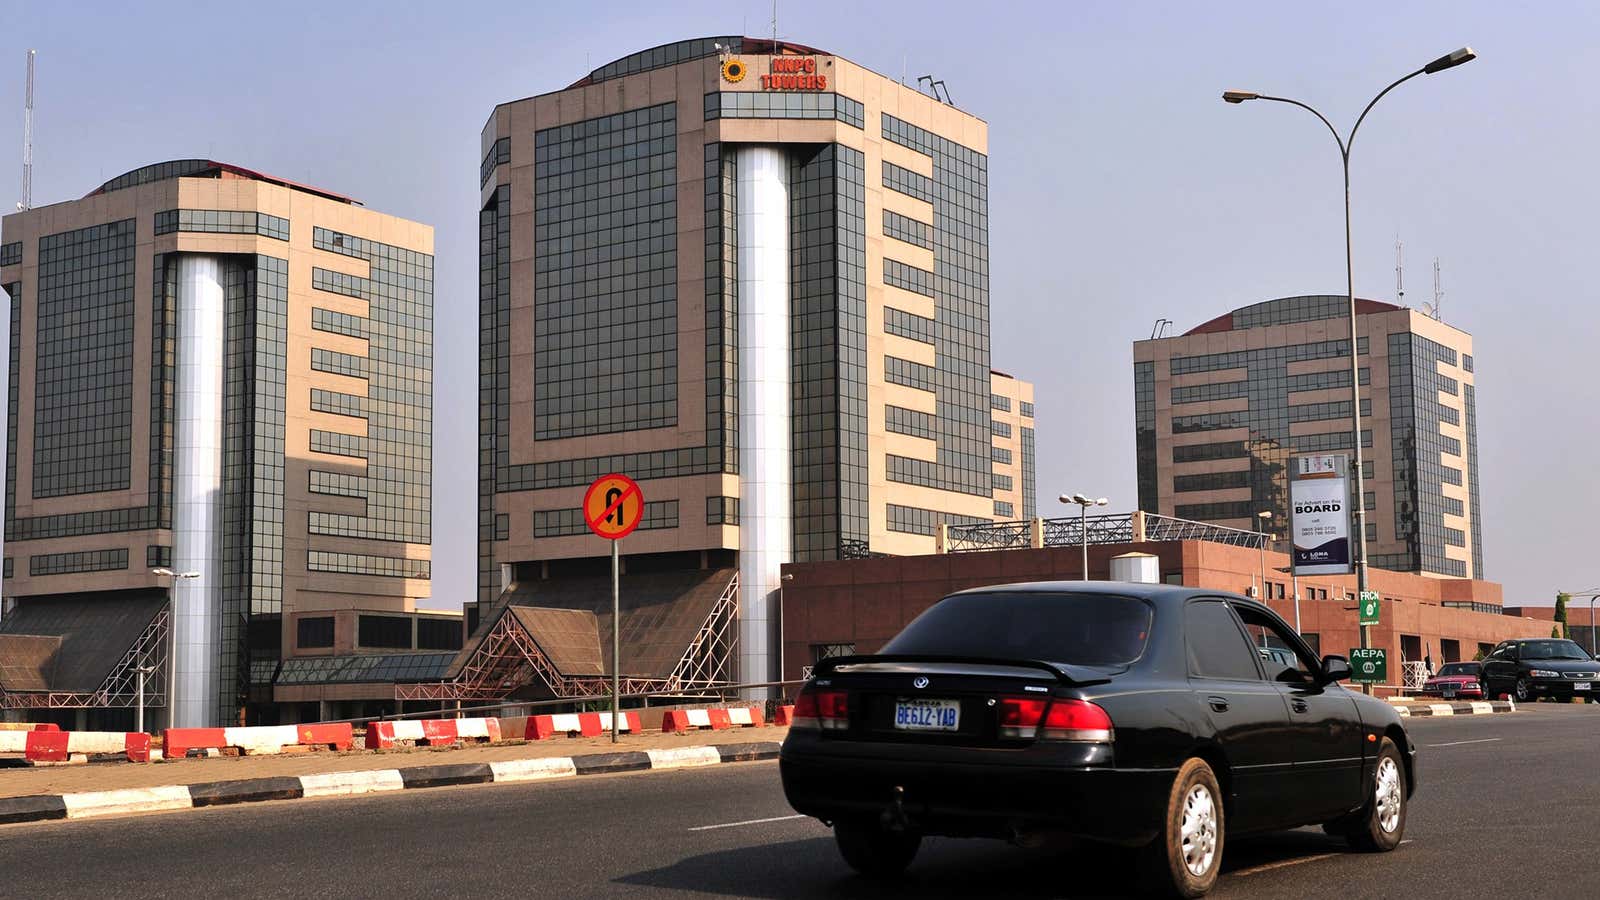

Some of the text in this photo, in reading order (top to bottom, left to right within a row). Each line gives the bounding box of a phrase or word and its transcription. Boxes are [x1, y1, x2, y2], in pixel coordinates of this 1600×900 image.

[773, 58, 815, 73] NNPC
[761, 74, 827, 90] TOWERS
[1295, 504, 1341, 514] BOARD
[1352, 649, 1385, 658] AEPA
